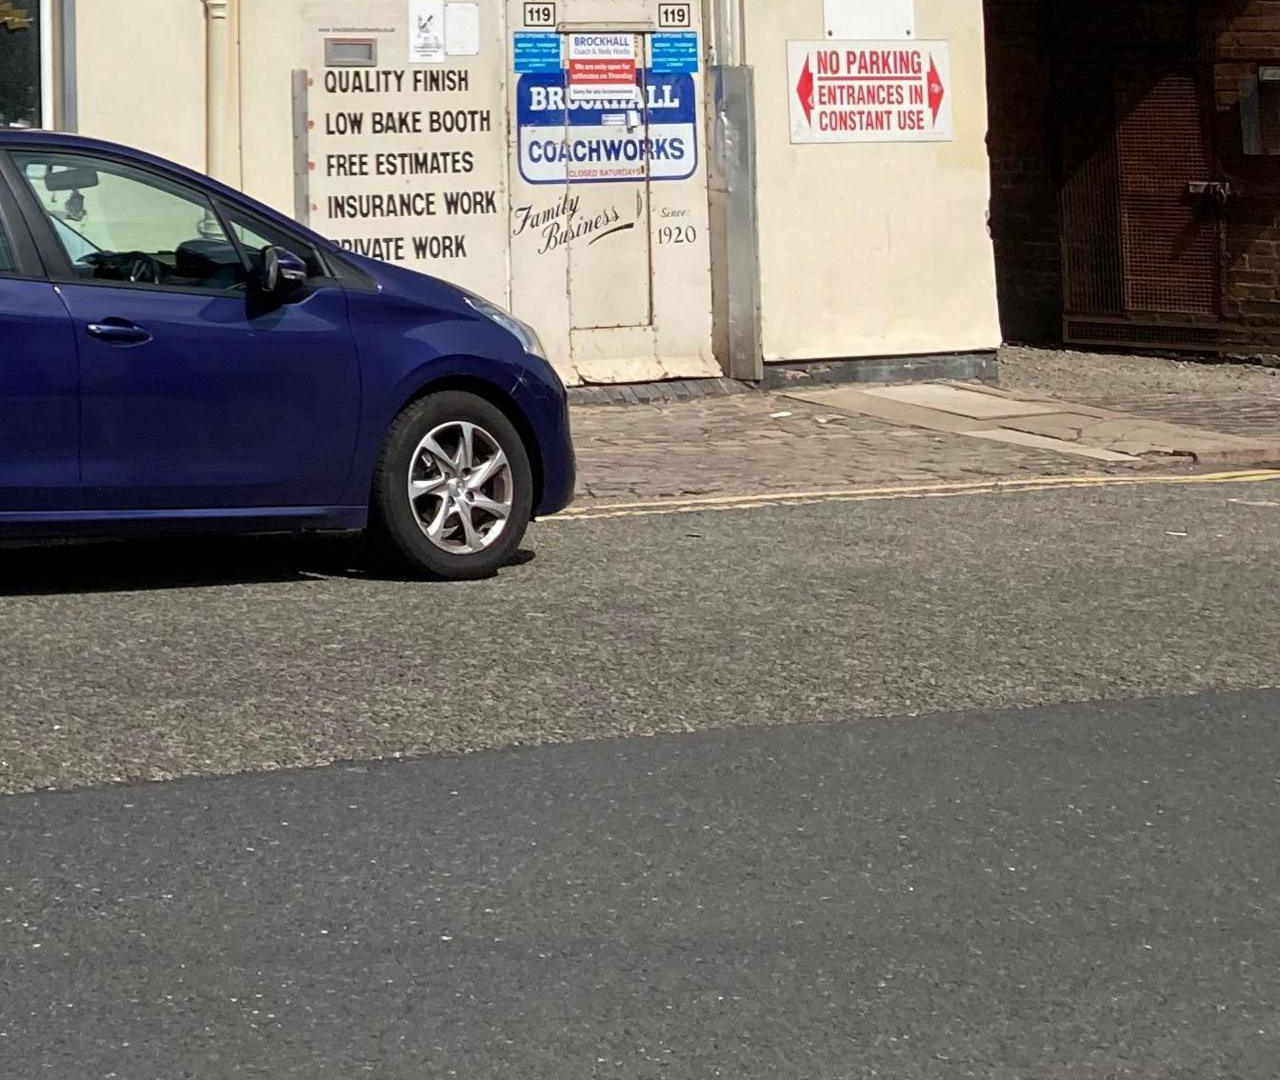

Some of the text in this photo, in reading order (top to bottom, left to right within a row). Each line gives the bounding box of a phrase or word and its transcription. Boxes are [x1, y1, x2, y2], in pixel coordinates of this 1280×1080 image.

[527, 7, 551, 22] 119
[662, 8, 686, 23] 119
[574, 36, 630, 47] BROCKHALL
[816, 50, 922, 75] NO PARKING
[324, 69, 469, 93] QUALITY FINISH
[818, 84, 924, 106] ENTRANCES IN
[325, 110, 491, 135] LOW BAKE BOOTH
[819, 109, 925, 131] CONSTANT USE
[528, 137, 685, 163] COACHWORKS
[326, 151, 473, 177] FREE ESTIMATES
[568, 167, 641, 177] CLOSED SATURDAYS
[328, 190, 497, 219] INSURANCE WORK
[513, 193, 580, 236] Family
[538, 206, 620, 255] Business
[657, 225, 697, 244] 1920
[412, 235, 467, 259] WORK
